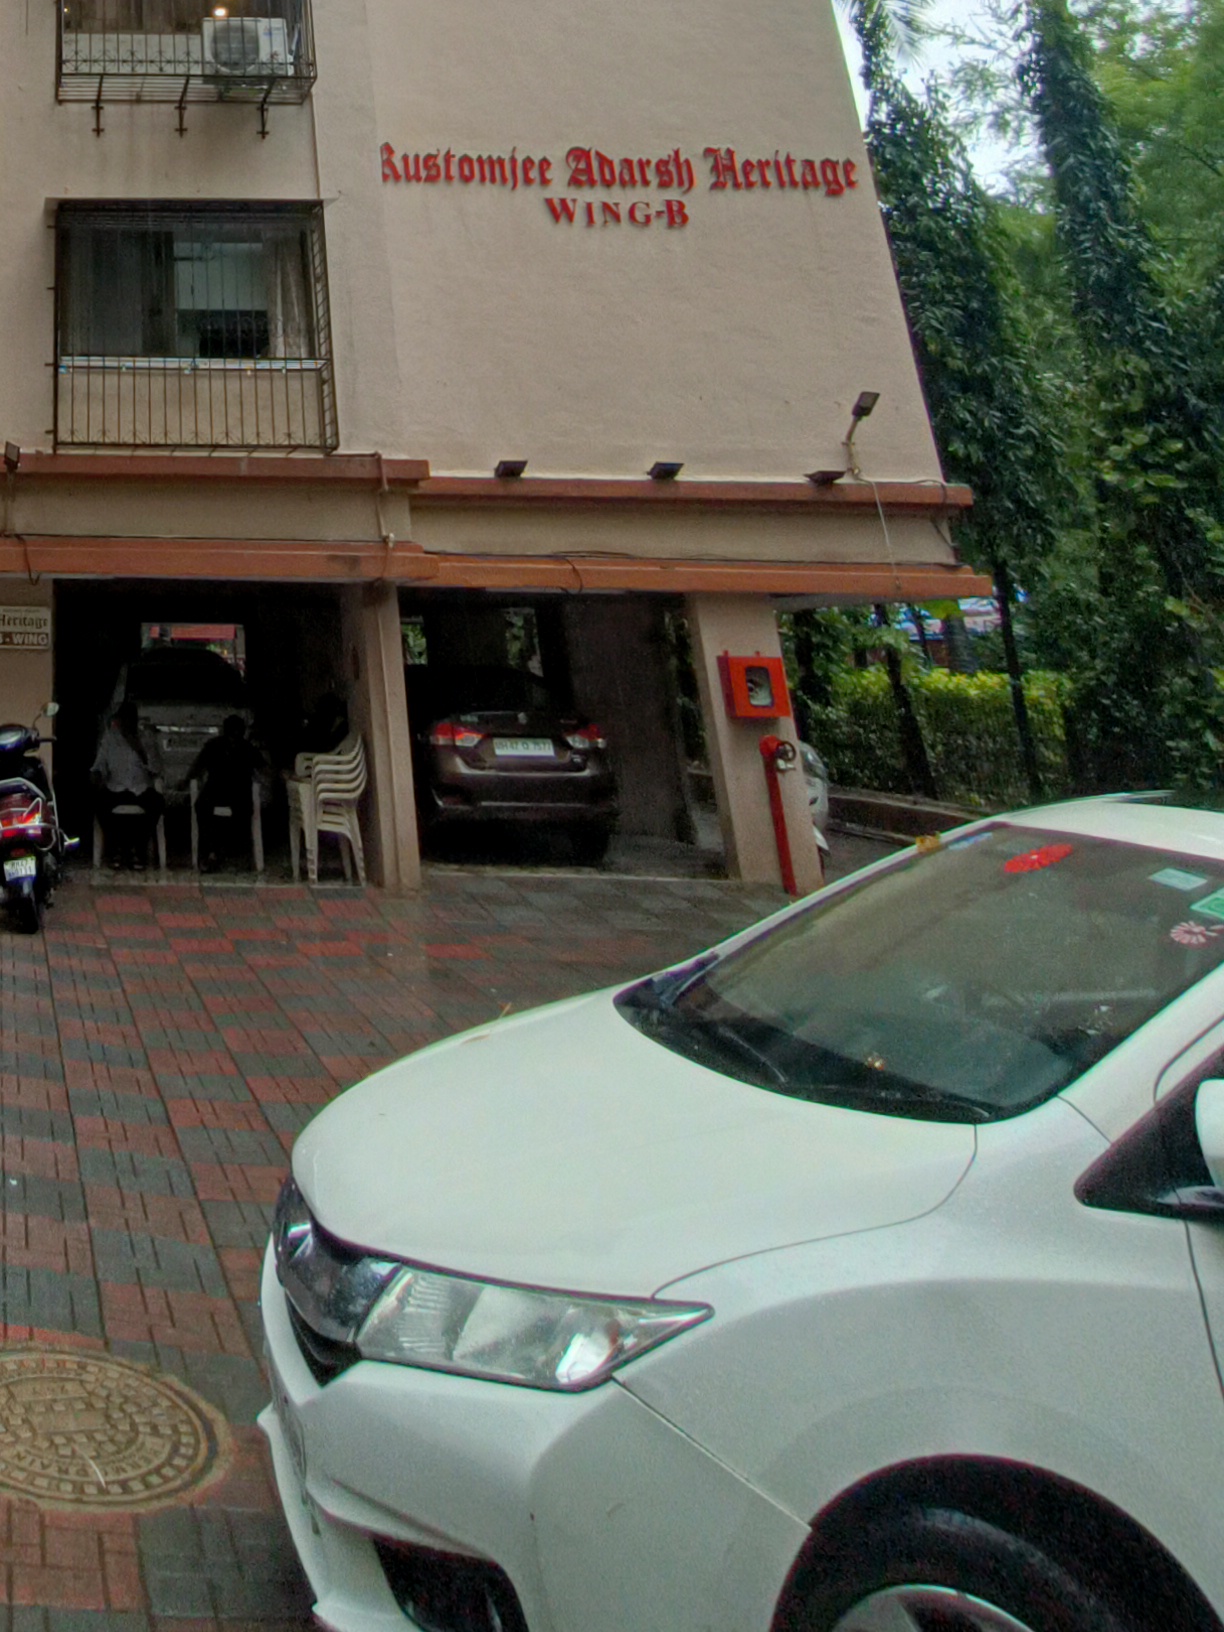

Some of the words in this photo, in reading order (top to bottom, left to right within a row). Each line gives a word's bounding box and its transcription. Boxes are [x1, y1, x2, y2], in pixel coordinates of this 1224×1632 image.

[380, 142, 553, 190] Rustomjee
[566, 146, 695, 193] Adarsh
[703, 147, 858, 196] Heritage
[13, 633, 48, 645] WING
